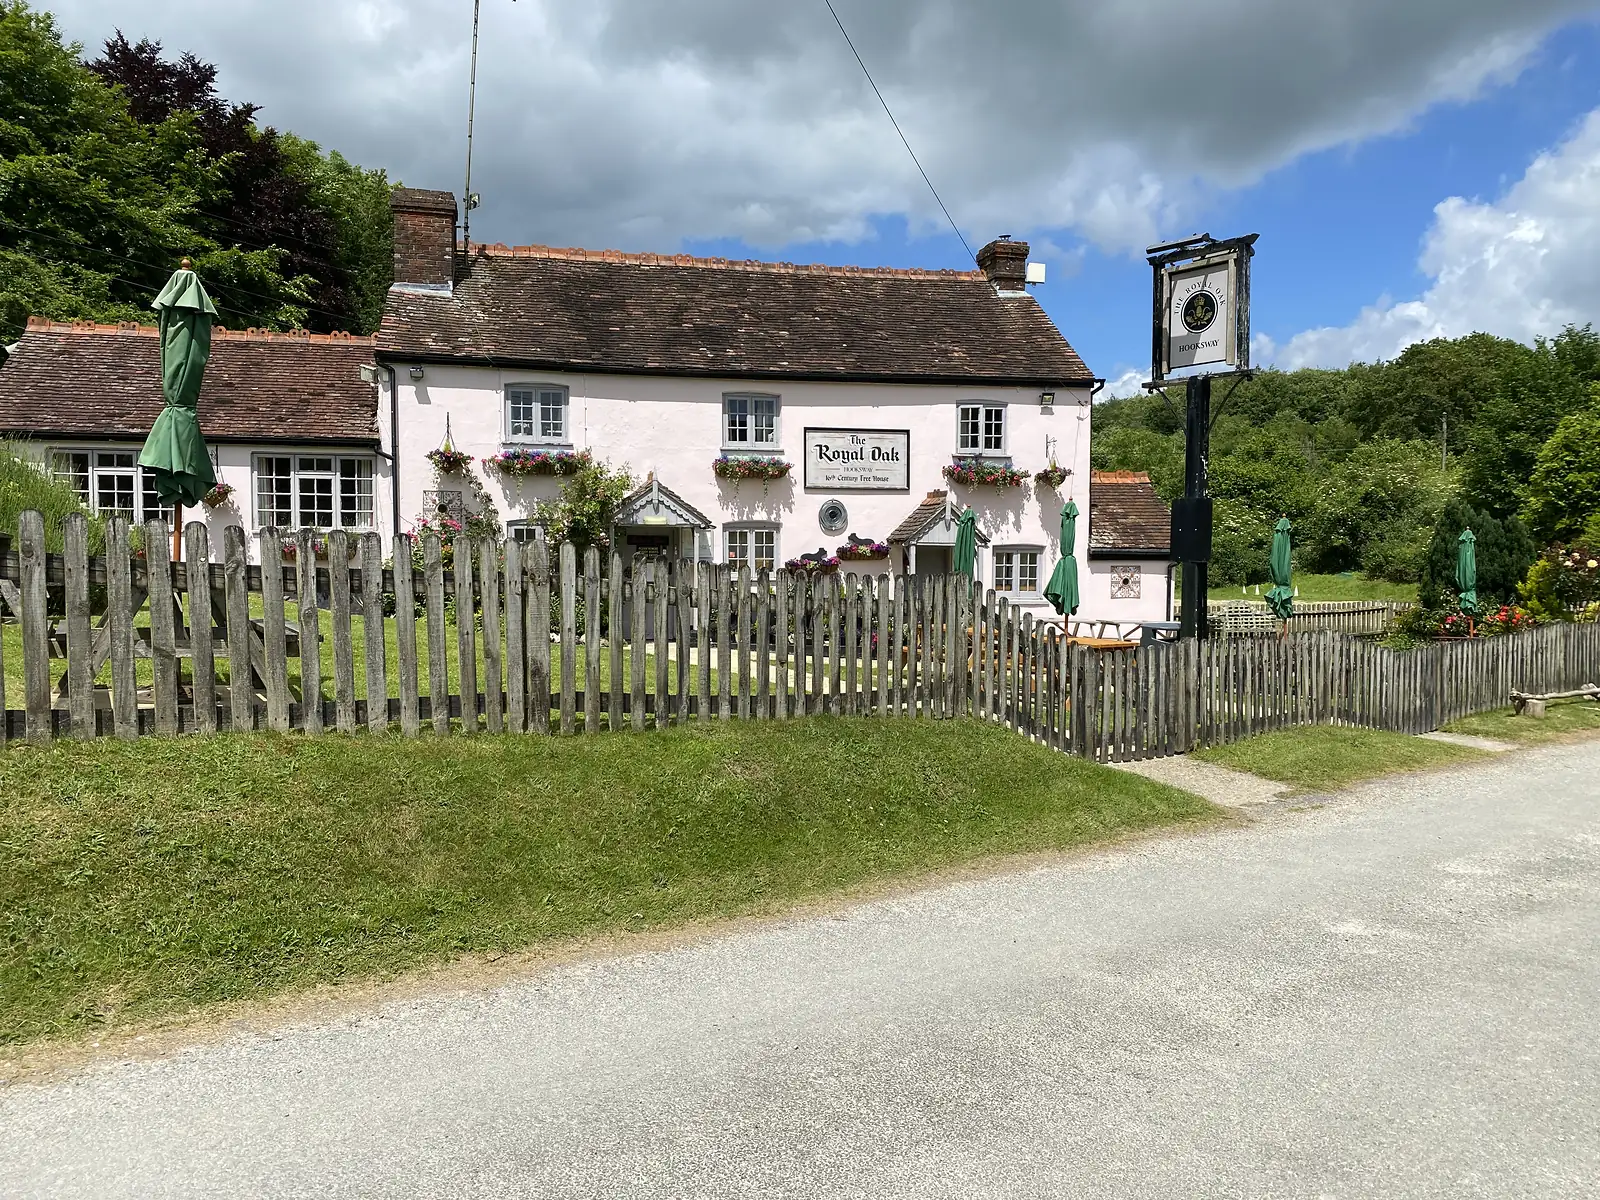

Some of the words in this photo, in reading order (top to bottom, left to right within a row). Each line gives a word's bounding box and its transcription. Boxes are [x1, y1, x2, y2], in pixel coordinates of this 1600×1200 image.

[1174, 296, 1184, 315] THE
[1185, 281, 1213, 294] ROYAL
[1215, 287, 1227, 307] OAK
[1178, 339, 1220, 353] HOOKSWAY
[849, 434, 866, 445] The
[813, 444, 865, 464] Royal
[870, 446, 900, 462] Oak
[837, 474, 858, 483] Century
[860, 474, 871, 482] Free
[872, 475, 890, 483] House
